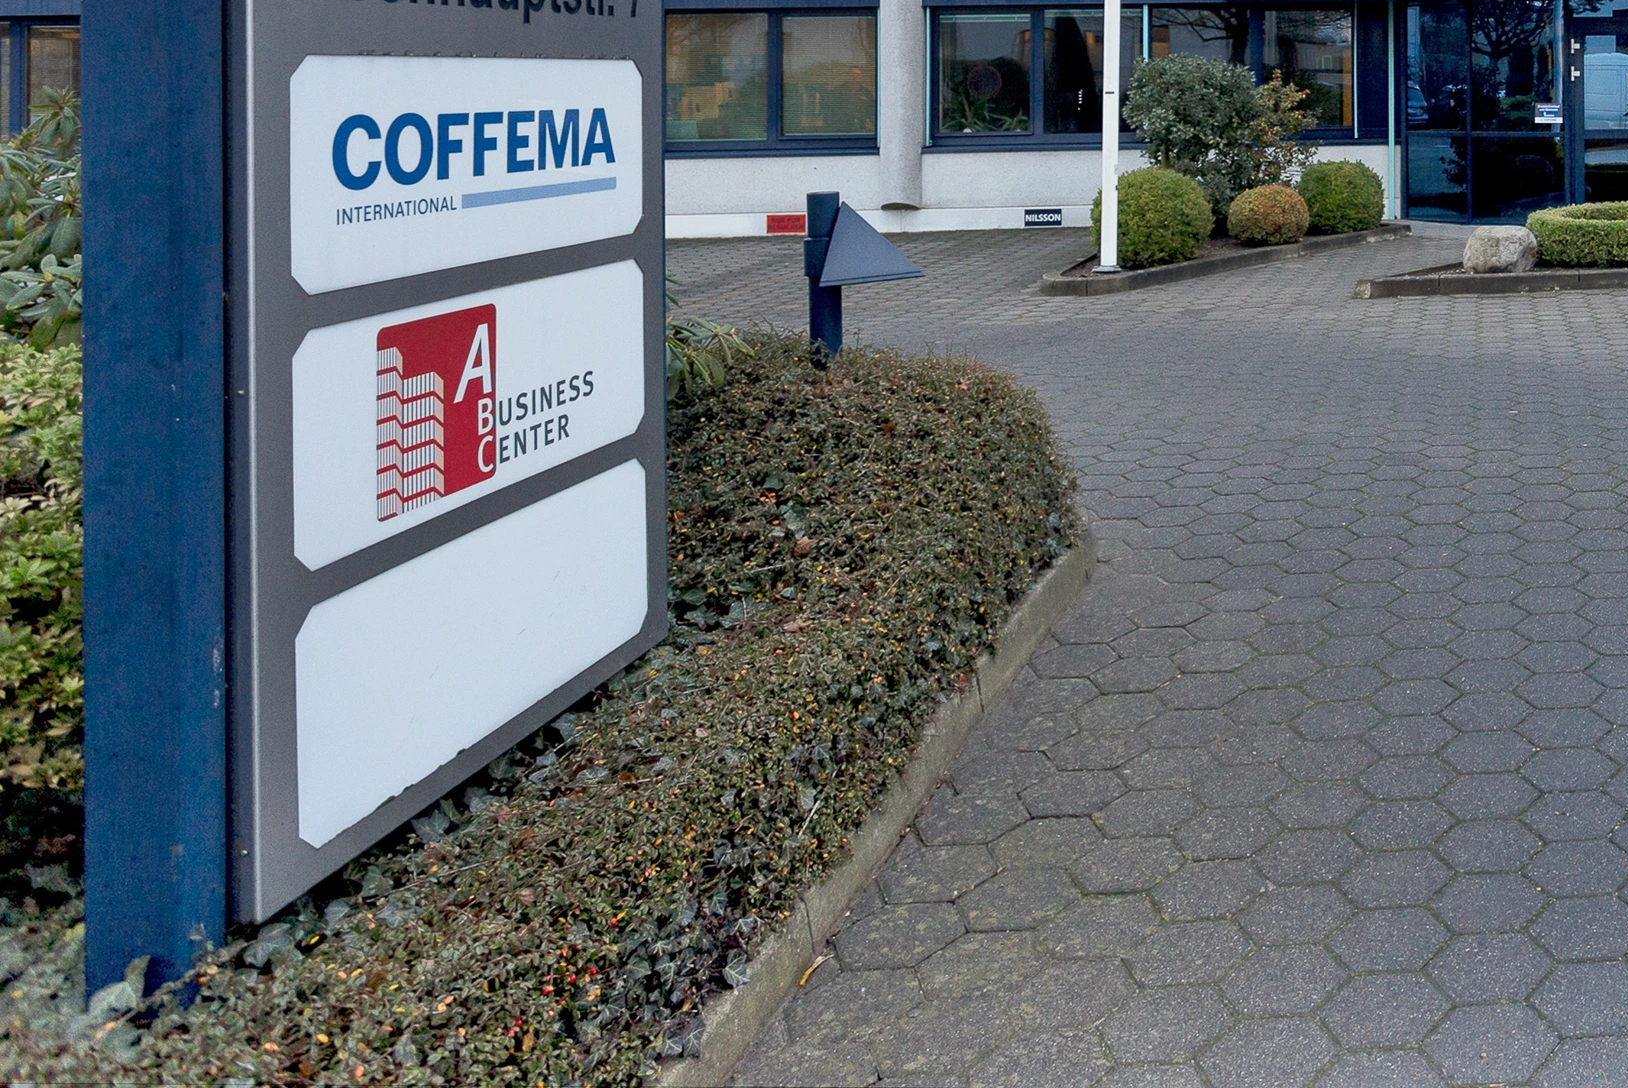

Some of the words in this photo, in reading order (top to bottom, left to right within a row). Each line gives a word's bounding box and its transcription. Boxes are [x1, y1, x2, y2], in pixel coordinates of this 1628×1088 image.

[332, 107, 617, 191] COFFEMA
[336, 194, 458, 226] INTERNATIONAL
[1025, 213, 1061, 222] NILSSON
[453, 323, 493, 404] A
[478, 370, 595, 435] BUSINESS
[478, 413, 570, 473] CENTER
